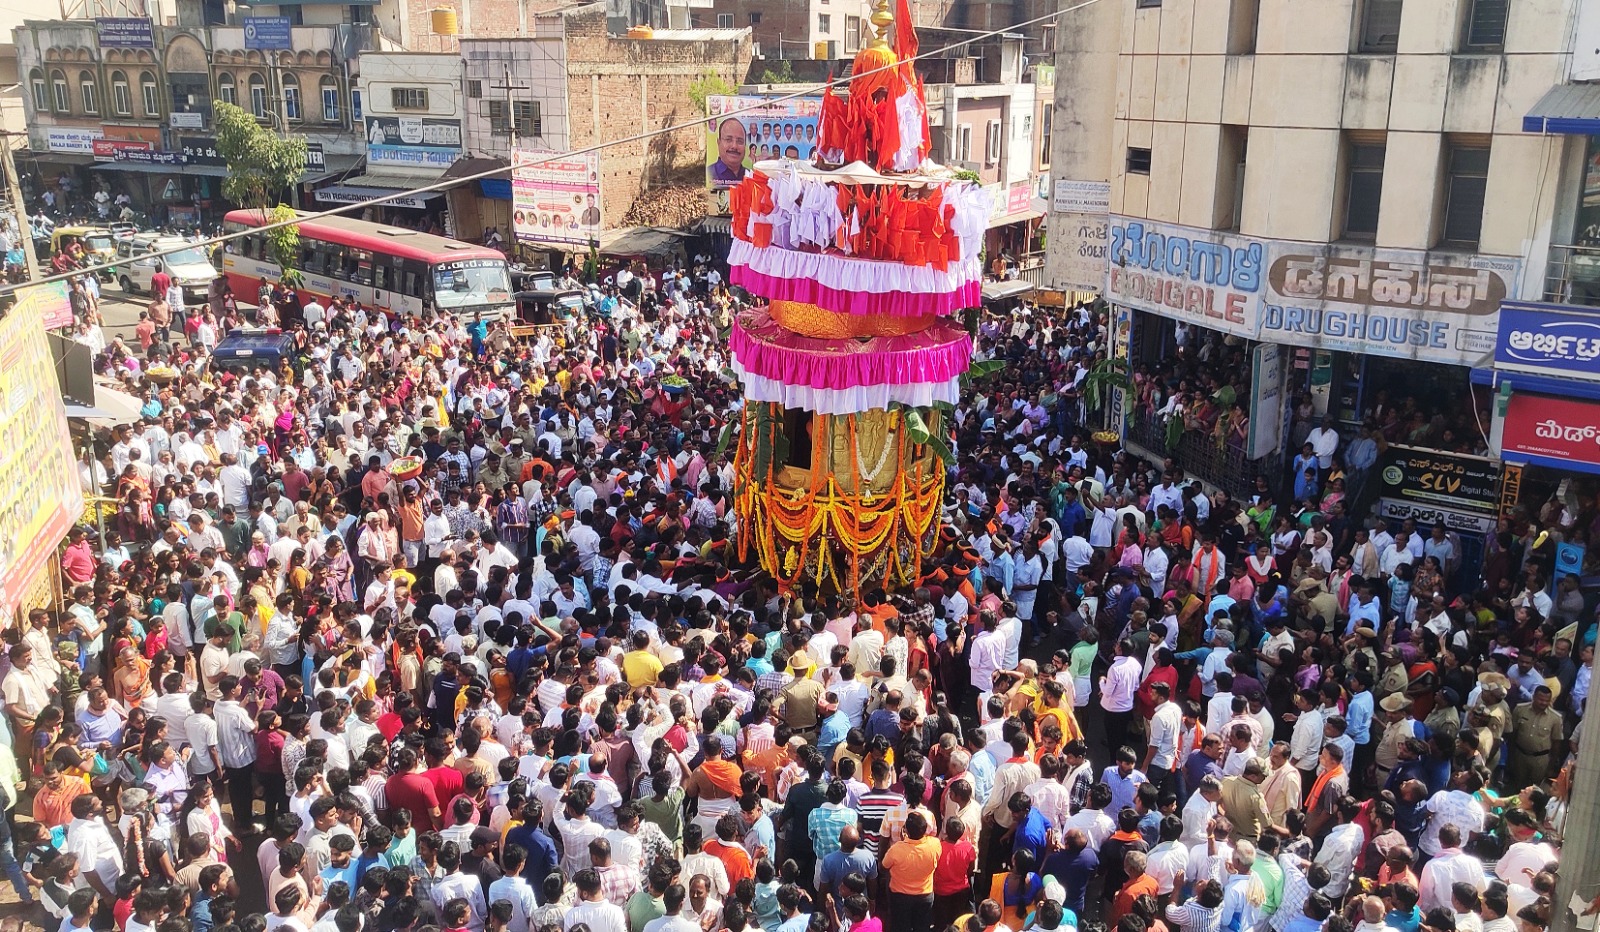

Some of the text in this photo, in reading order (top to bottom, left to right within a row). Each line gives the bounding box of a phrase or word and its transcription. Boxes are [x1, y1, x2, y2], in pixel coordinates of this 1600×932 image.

[1110, 267, 1248, 325] BONGALE
[1420, 472, 1461, 493] SLV
[1461, 484, 1481, 495] Digital
